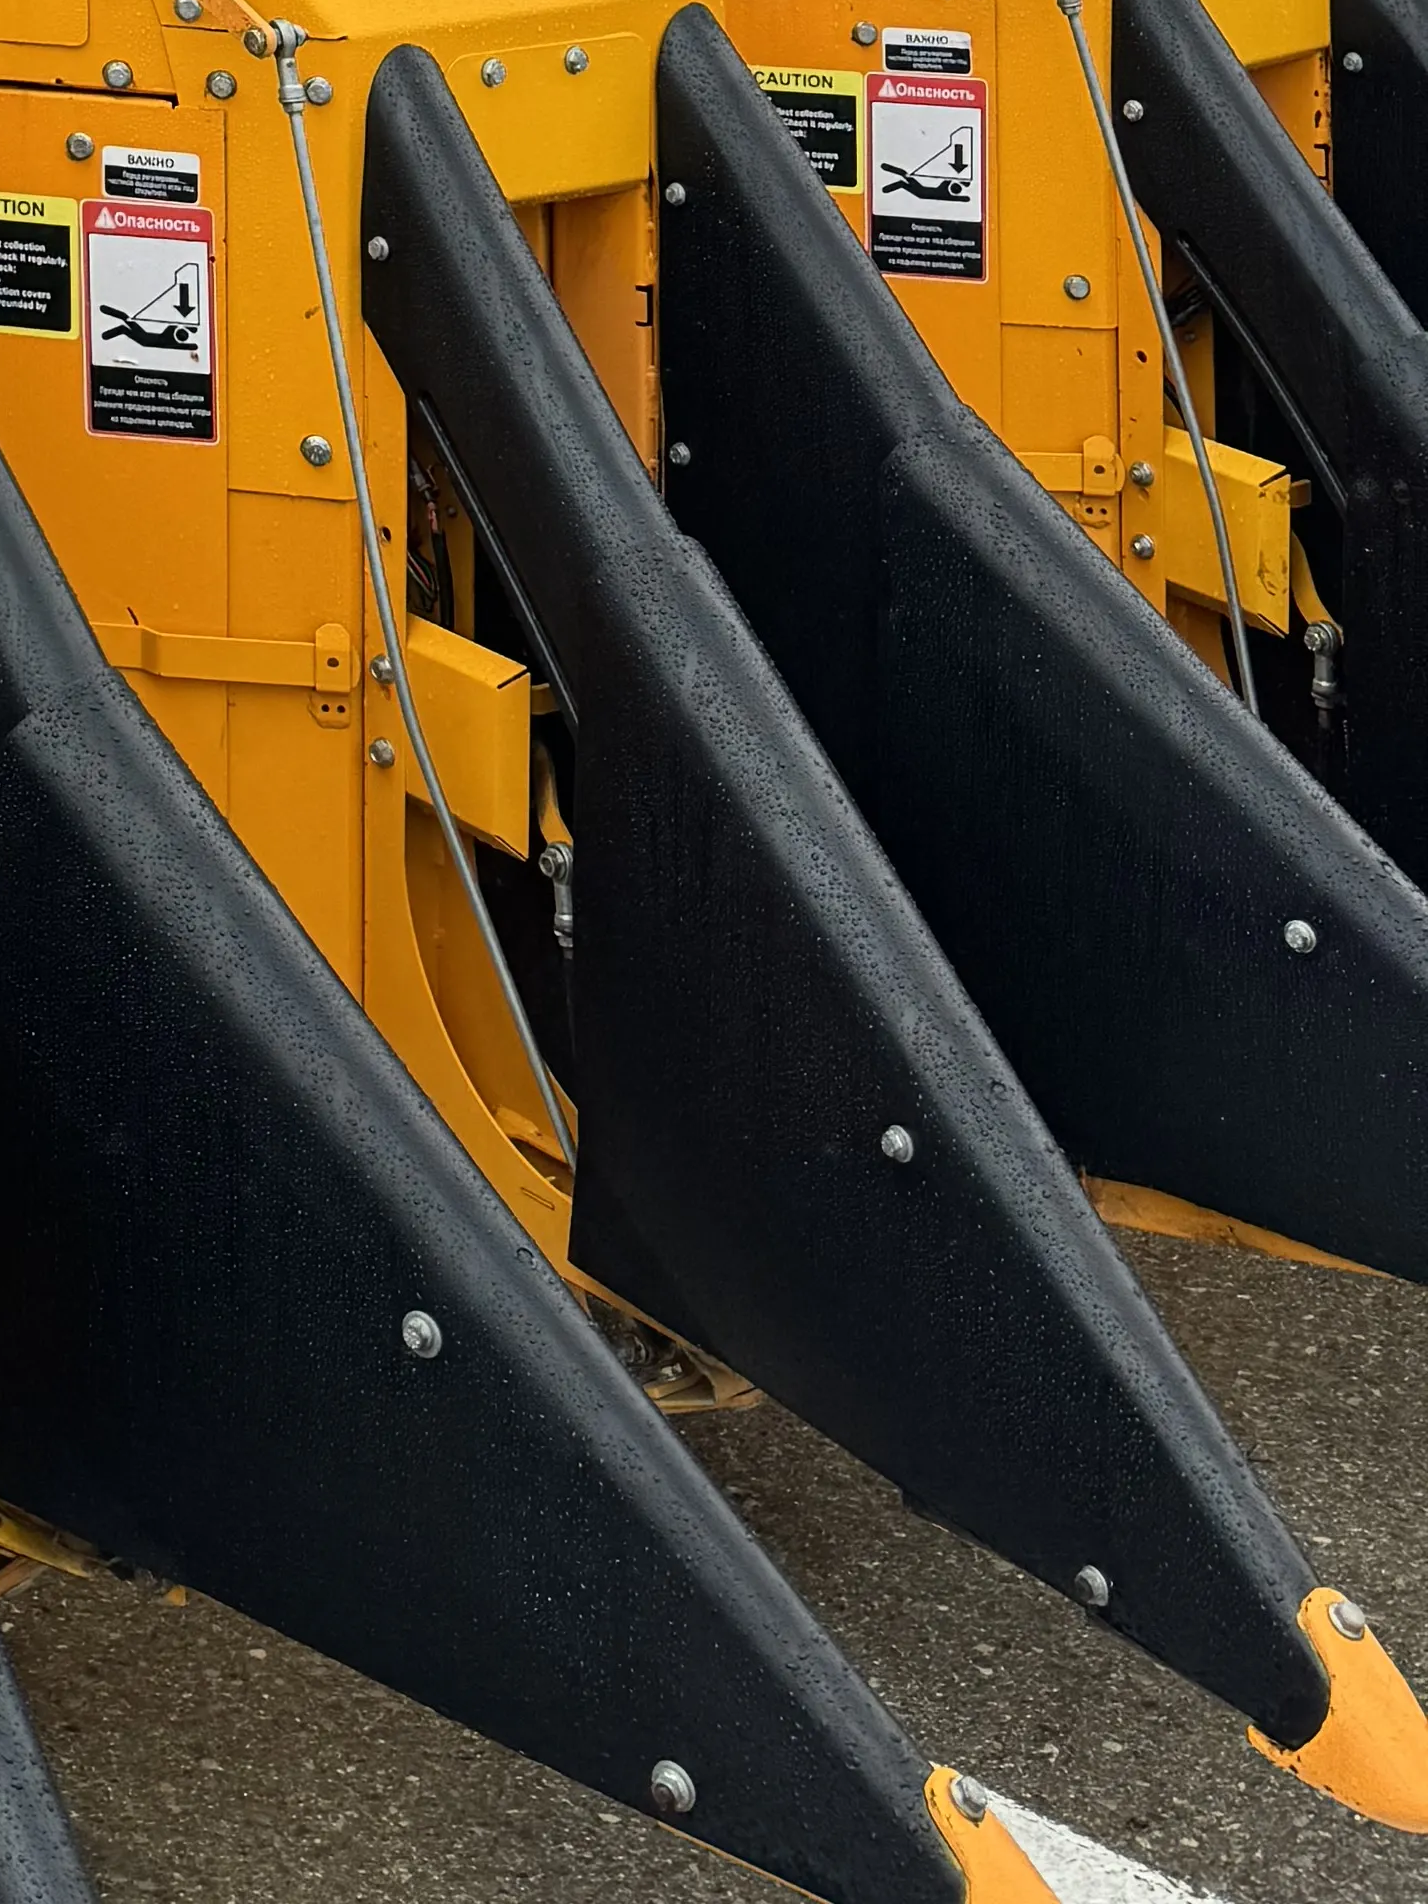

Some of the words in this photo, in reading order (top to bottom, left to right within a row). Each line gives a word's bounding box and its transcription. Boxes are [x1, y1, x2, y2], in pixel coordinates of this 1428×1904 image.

[754, 71, 833, 89] CAUTION
[896, 82, 975, 101] Опасность
[128, 154, 174, 169] ВАЖНО
[114, 211, 200, 233] Опасность
[35, 303, 47, 312] by
